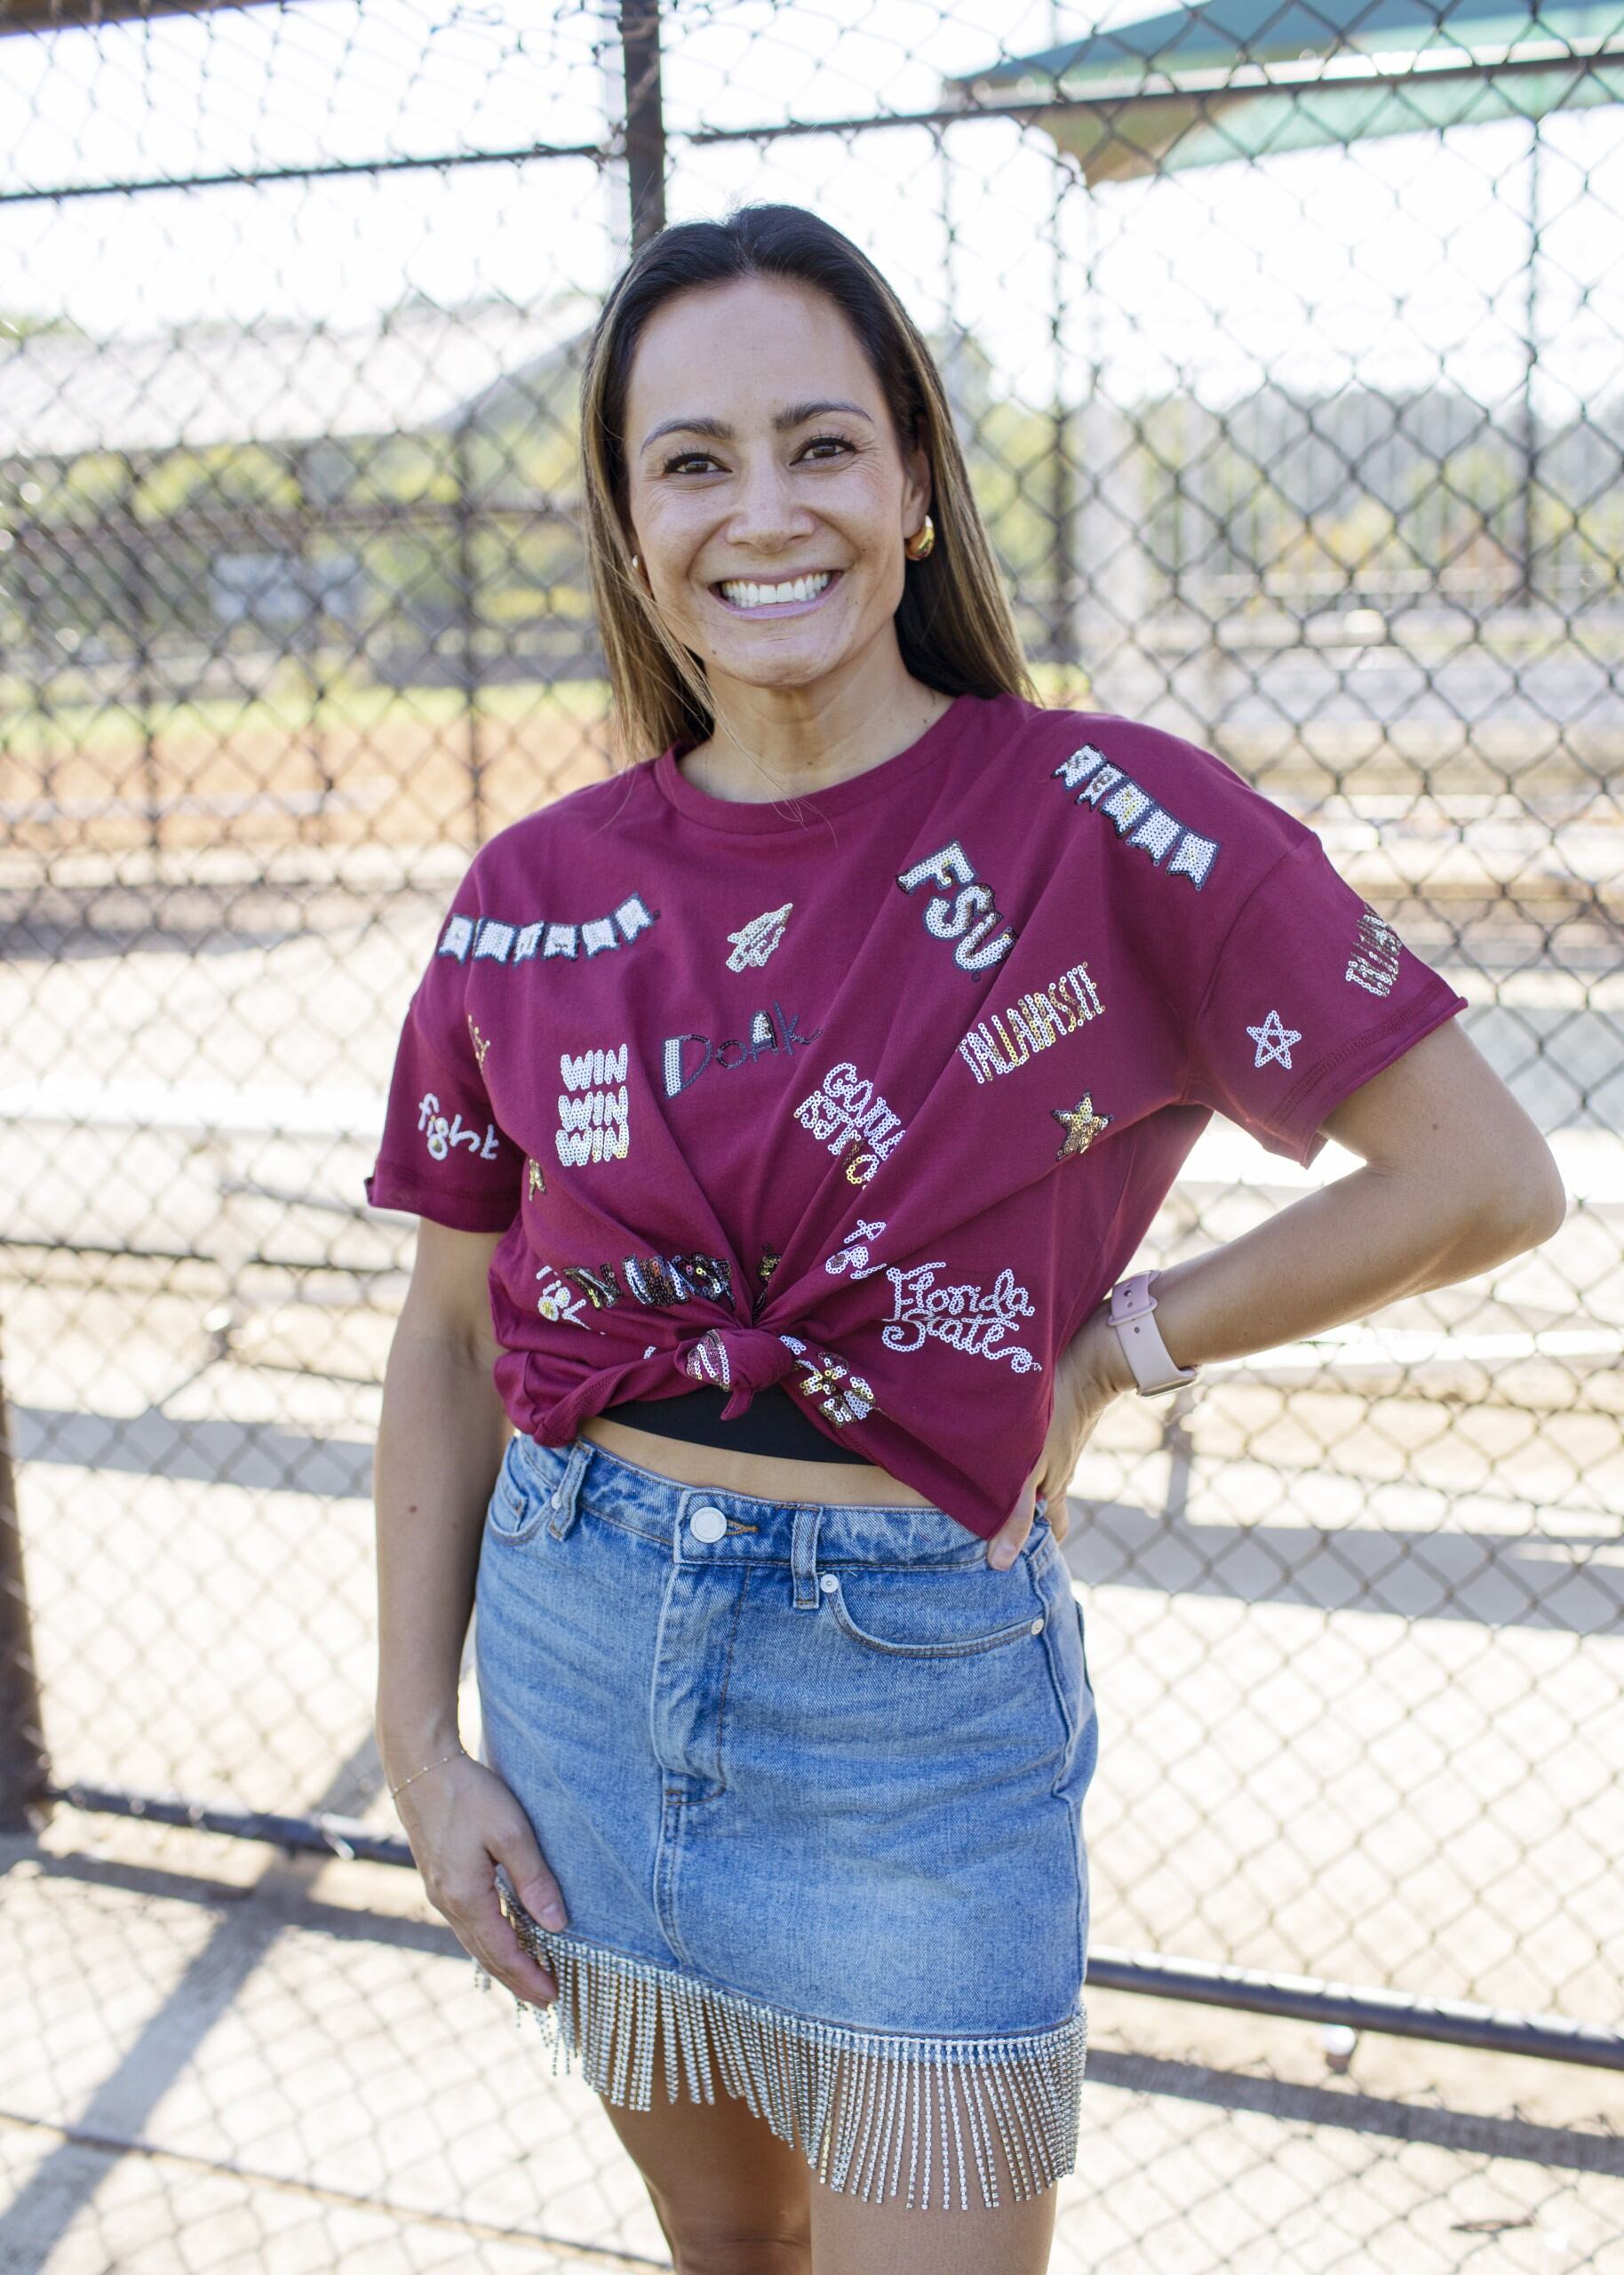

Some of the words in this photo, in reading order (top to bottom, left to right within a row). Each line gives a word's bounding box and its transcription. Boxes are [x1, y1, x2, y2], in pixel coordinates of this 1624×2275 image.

[896, 838, 1018, 973] FSU
[560, 1042, 628, 1091] WIN
[418, 1092, 499, 1161] fight
[558, 1085, 629, 1132] WIN
[555, 1122, 630, 1167] WIN
[886, 1261, 1036, 1321] Florida
